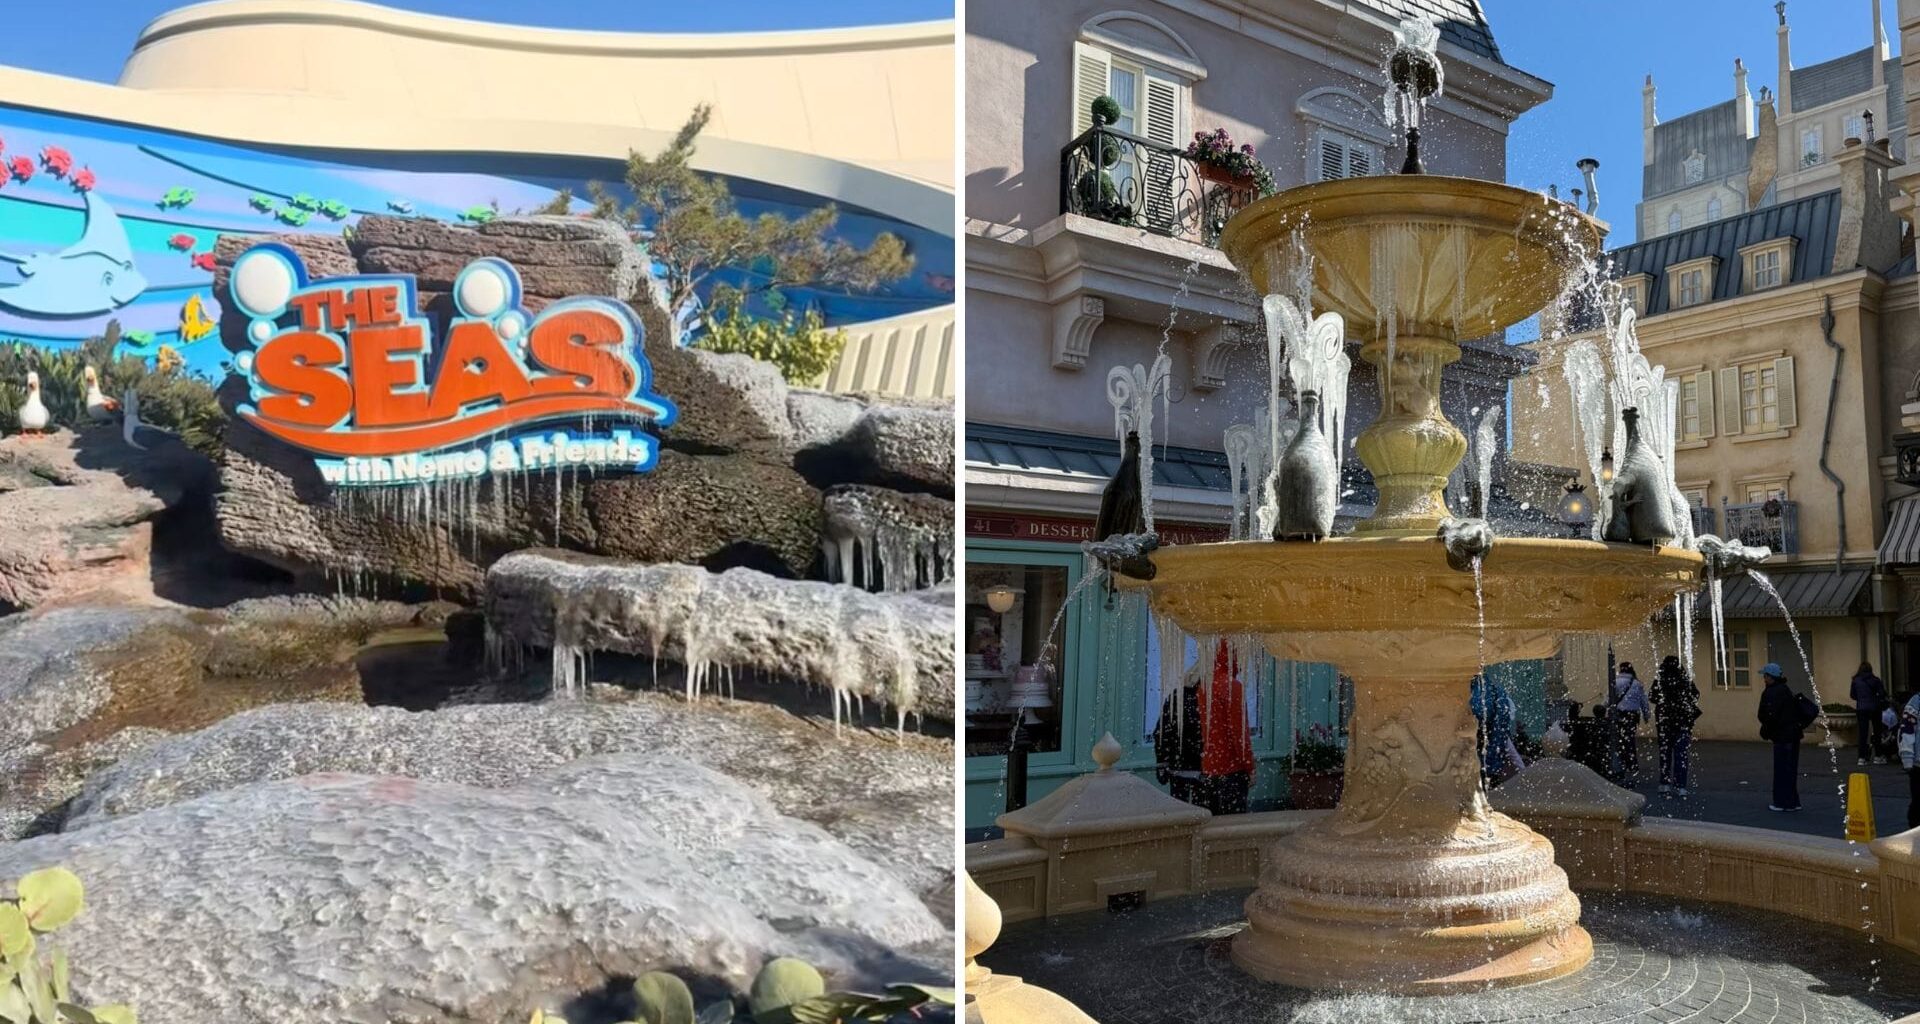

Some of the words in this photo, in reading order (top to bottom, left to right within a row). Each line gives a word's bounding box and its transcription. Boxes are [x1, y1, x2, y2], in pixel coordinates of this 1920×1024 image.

[292, 286, 402, 330] THE
[255, 310, 637, 428] SEAS
[317, 457, 393, 481] with
[393, 449, 486, 480] Nemo
[491, 441, 519, 472] &
[520, 431, 649, 466] Friends
[974, 519, 991, 532] 41
